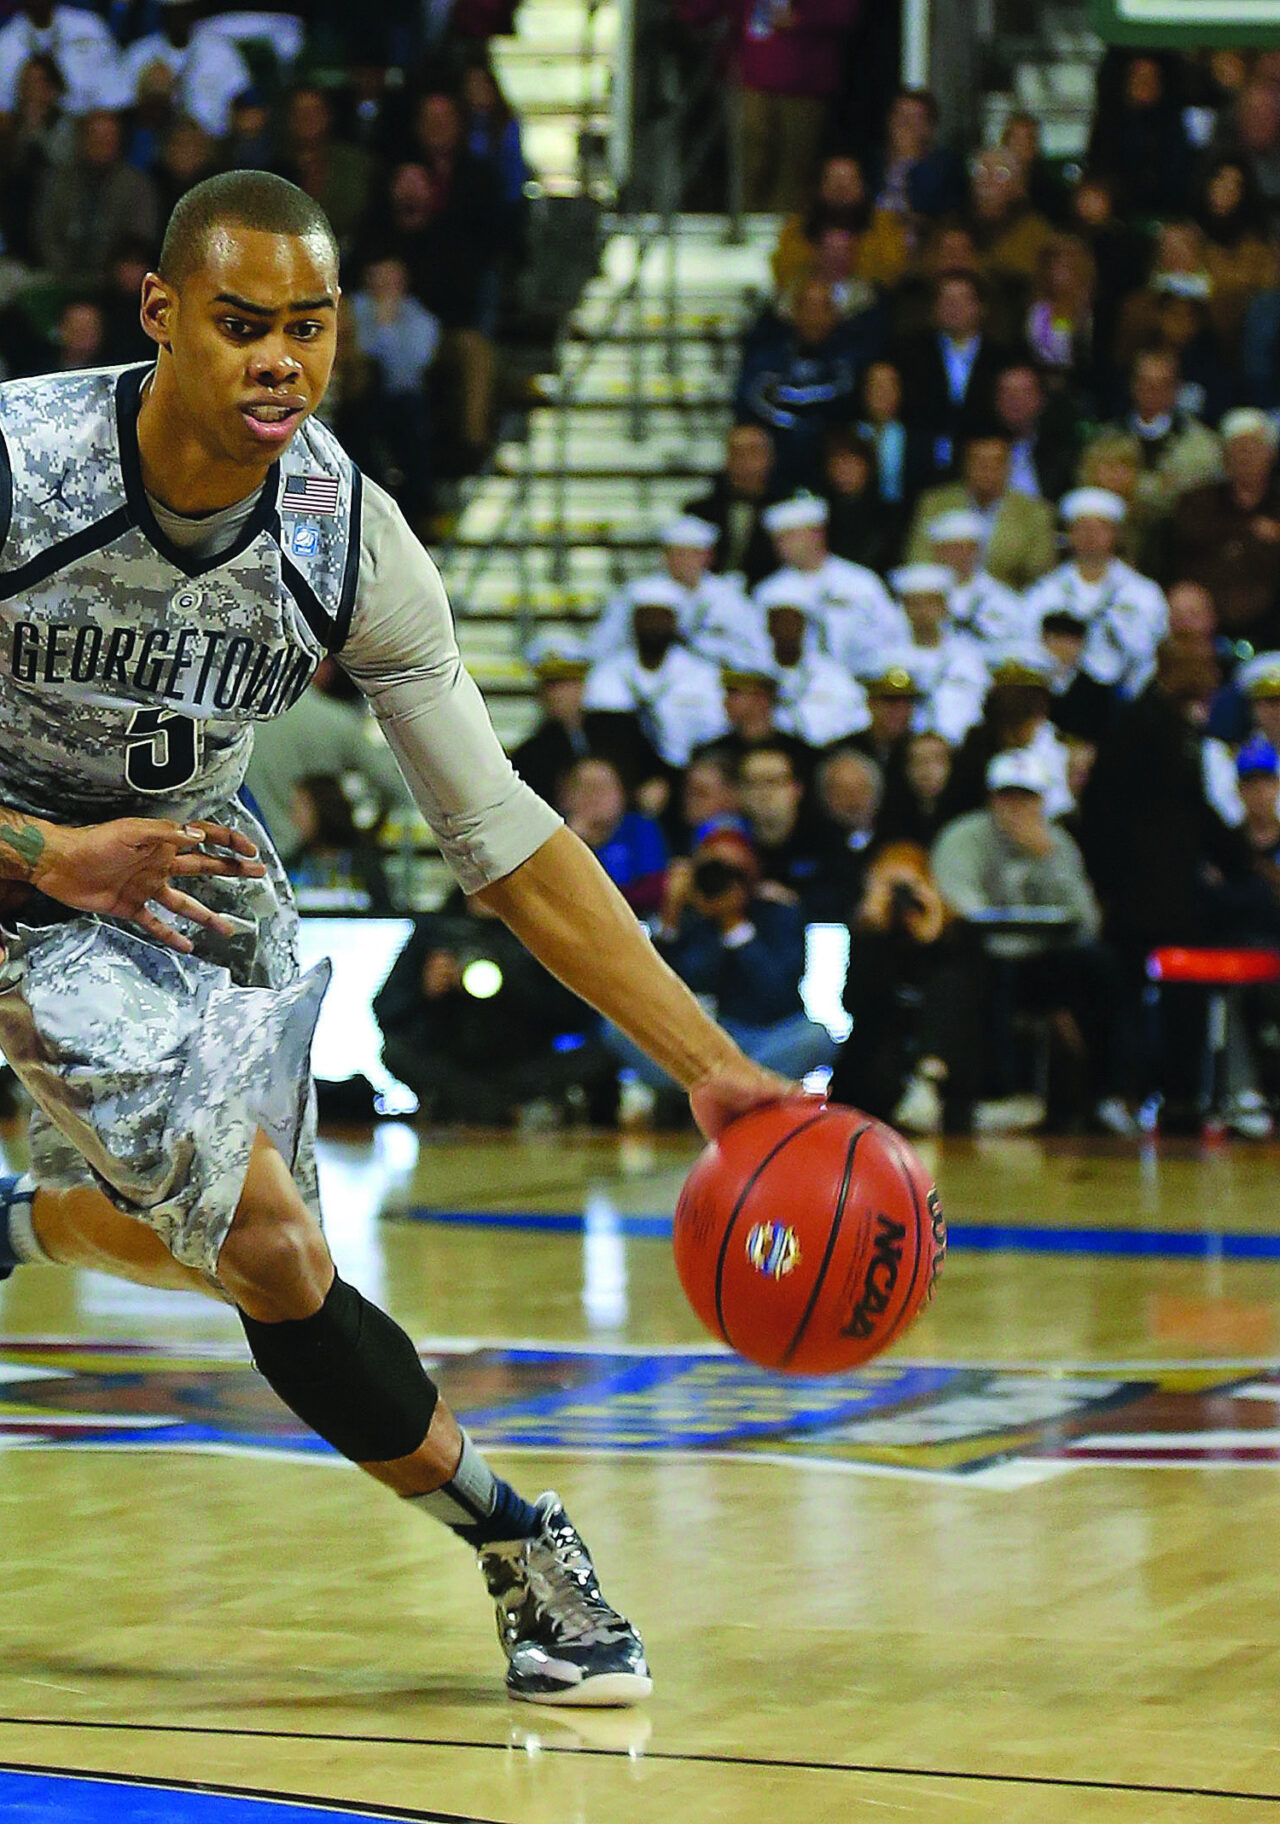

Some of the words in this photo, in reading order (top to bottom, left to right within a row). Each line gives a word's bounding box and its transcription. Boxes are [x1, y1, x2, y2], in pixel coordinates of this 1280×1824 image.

[11, 621, 316, 715] GEORGETOWN
[125, 706, 198, 793] 5
[839, 1213, 907, 1340] NCAA
